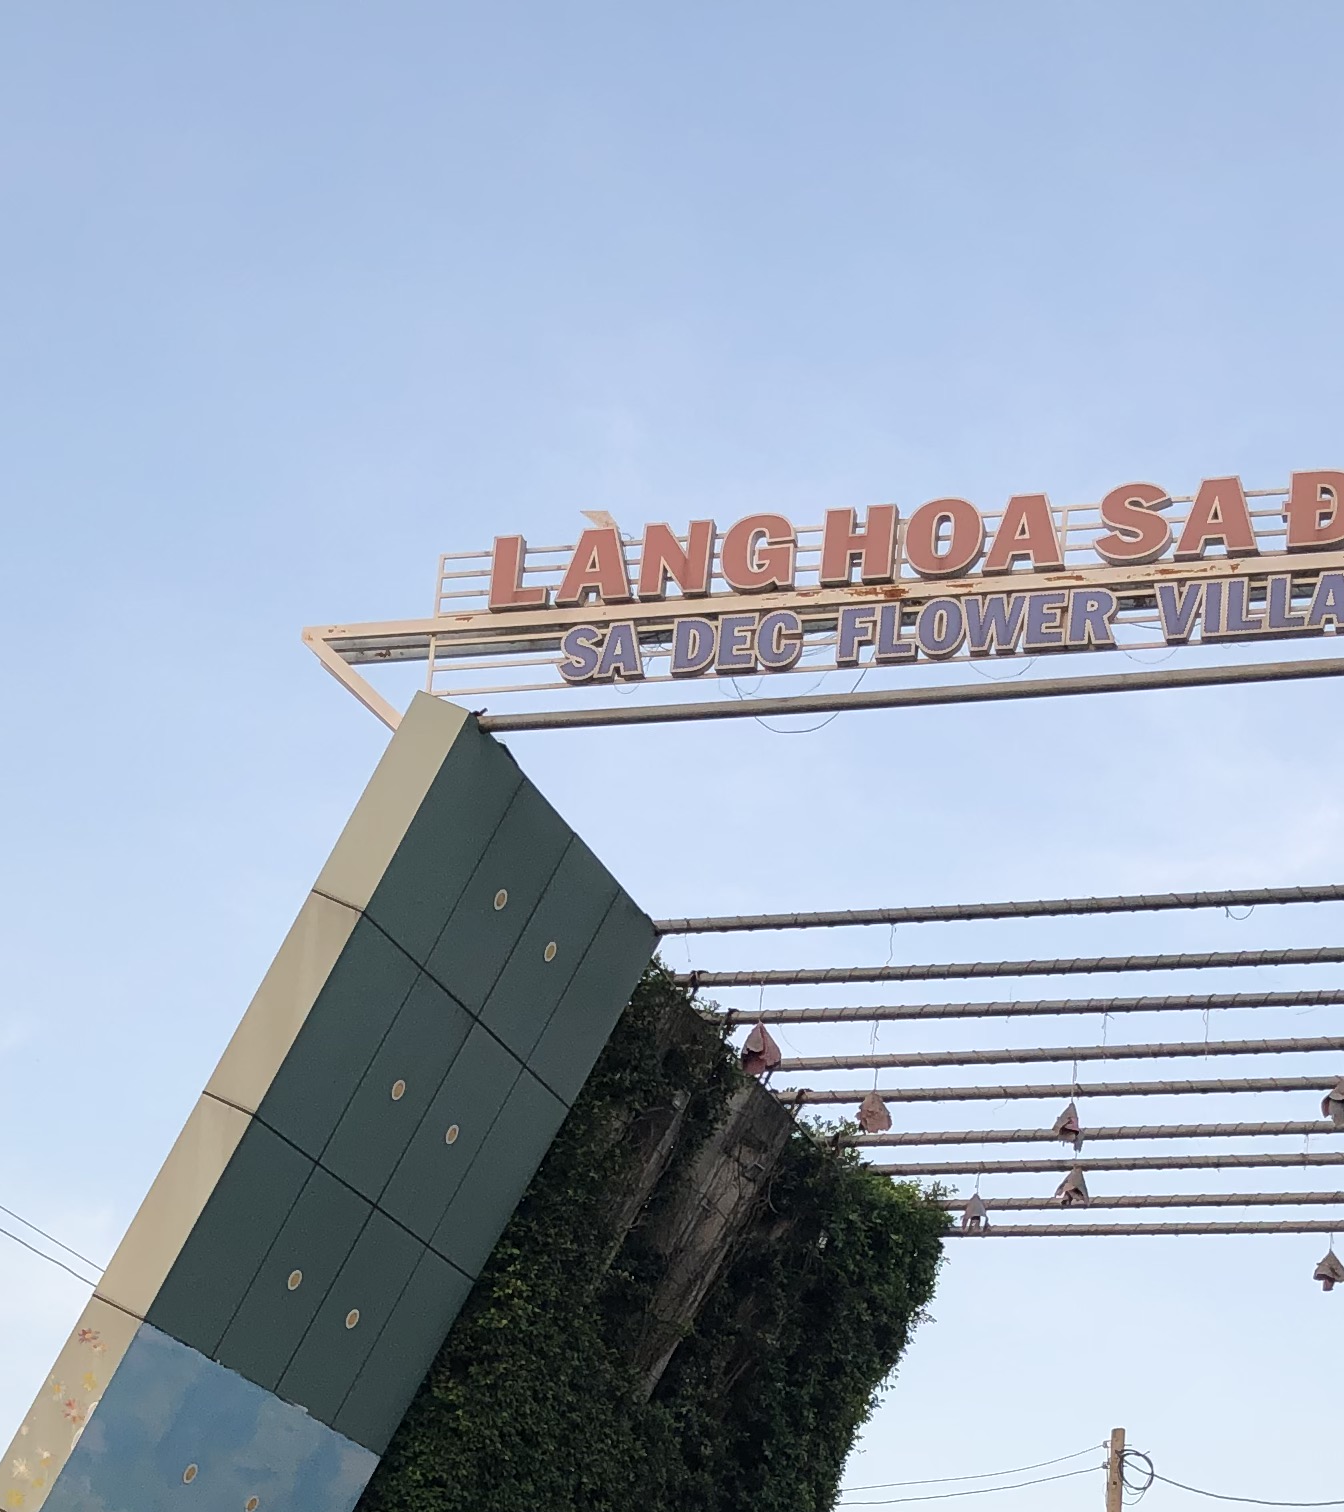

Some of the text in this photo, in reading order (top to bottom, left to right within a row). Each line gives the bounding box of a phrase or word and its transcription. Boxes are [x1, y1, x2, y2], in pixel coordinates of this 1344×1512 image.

[488, 510, 798, 613] LÀNG
[818, 492, 1066, 589] HOA
[1093, 475, 1260, 566] SA
[557, 620, 646, 686] SA
[669, 609, 805, 678] DEC
[835, 588, 1119, 669] FLOWER
